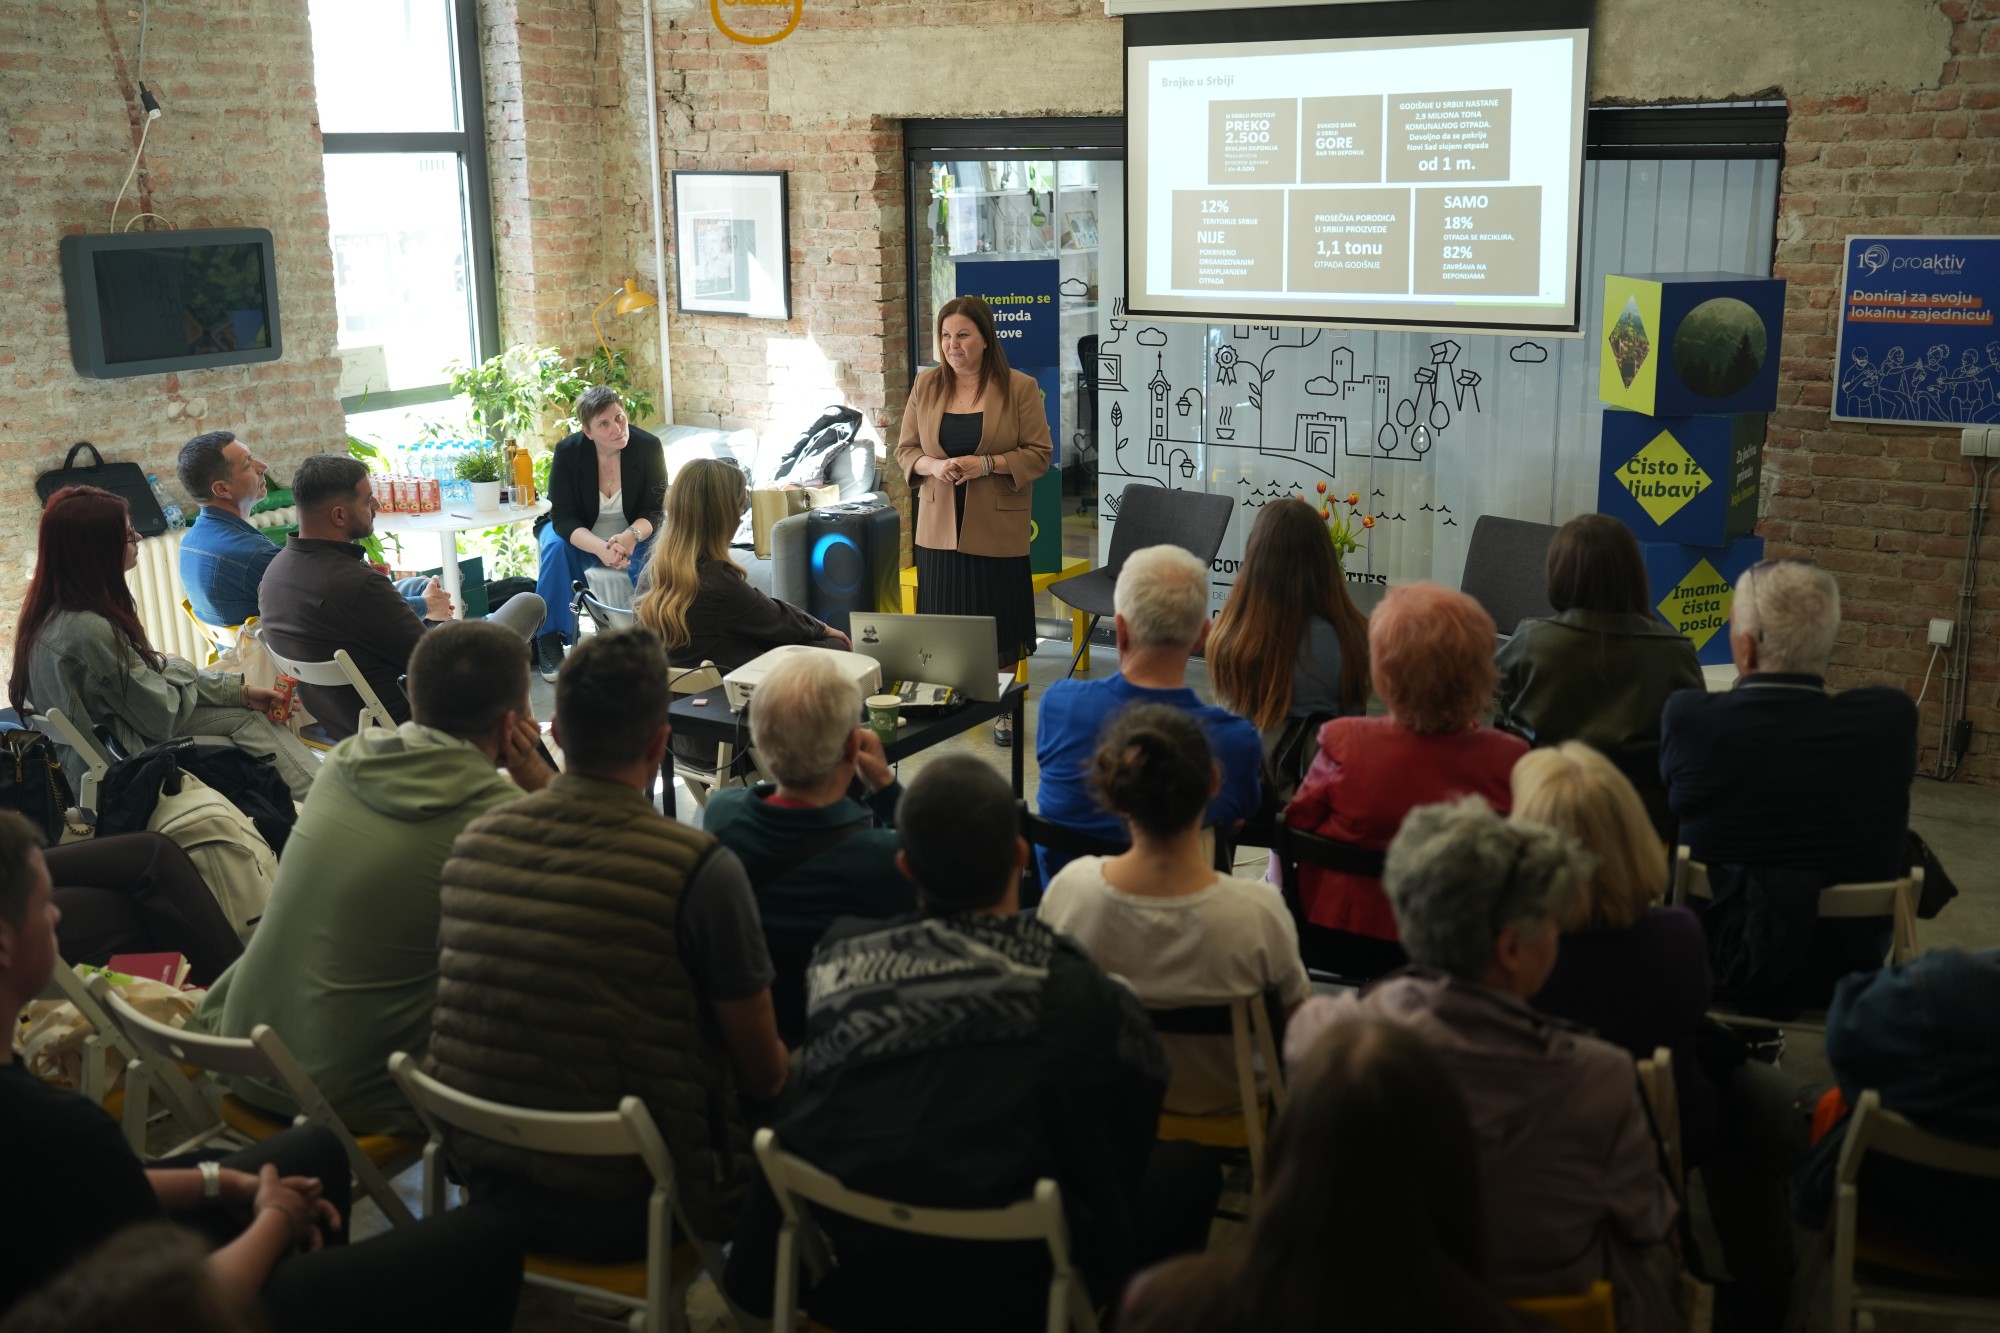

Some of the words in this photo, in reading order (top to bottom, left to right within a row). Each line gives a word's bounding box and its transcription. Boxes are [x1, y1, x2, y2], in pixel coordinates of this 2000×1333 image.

[1162, 78, 1194, 89] Brojke
[1206, 75, 1234, 88] Srbiji
[1400, 100, 1434, 110] GODIŠNJE
[1443, 100, 1464, 108] SRBIJI
[1465, 99, 1499, 108] NASTANE
[1415, 113, 1427, 121] 2,9
[1428, 112, 1459, 120] MILIONA
[1225, 120, 1270, 131] PREKO
[1406, 122, 1458, 130] KOMUNALNOG
[1460, 121, 1491, 129] OTPADA.
[1225, 132, 1270, 144] 2.500
[1316, 137, 1353, 149] GORE
[1409, 133, 1440, 142] Dovoljno
[1464, 132, 1487, 141] pokrije
[1438, 142, 1462, 152] slojem
[1464, 142, 1489, 151] otpada
[1419, 157, 1437, 171] od
[1442, 157, 1451, 170] 1
[1456, 159, 1476, 170] m.
[1200, 200, 1229, 213] 12%
[1444, 195, 1488, 208] SAMO
[1315, 213, 1354, 222] PROSEČNA
[1444, 216, 1473, 229] 18%
[1197, 231, 1225, 244] NIJE
[1317, 240, 1340, 257] 1,1
[1345, 240, 1382, 255] tonu
[1443, 246, 1473, 259] 82%
[1344, 260, 1381, 269] GODIŠNJE
[1892, 254, 1966, 272] proaktiv
[1037, 295, 1051, 304] se
[1853, 290, 1906, 303] Doniraj
[1910, 293, 1927, 302] za
[1931, 292, 1973, 305] svoju
[993, 310, 1032, 321] riroda
[1851, 306, 1906, 320] lokalnu
[1910, 308, 1990, 322] zajednicu!
[1627, 454, 1679, 476] Čisto
[1685, 462, 1701, 477] iz
[1628, 479, 1701, 501] ljubavi
[1672, 582, 1730, 601] Imamo
[1682, 599, 1721, 615] čista
[1680, 614, 1724, 634] posla
